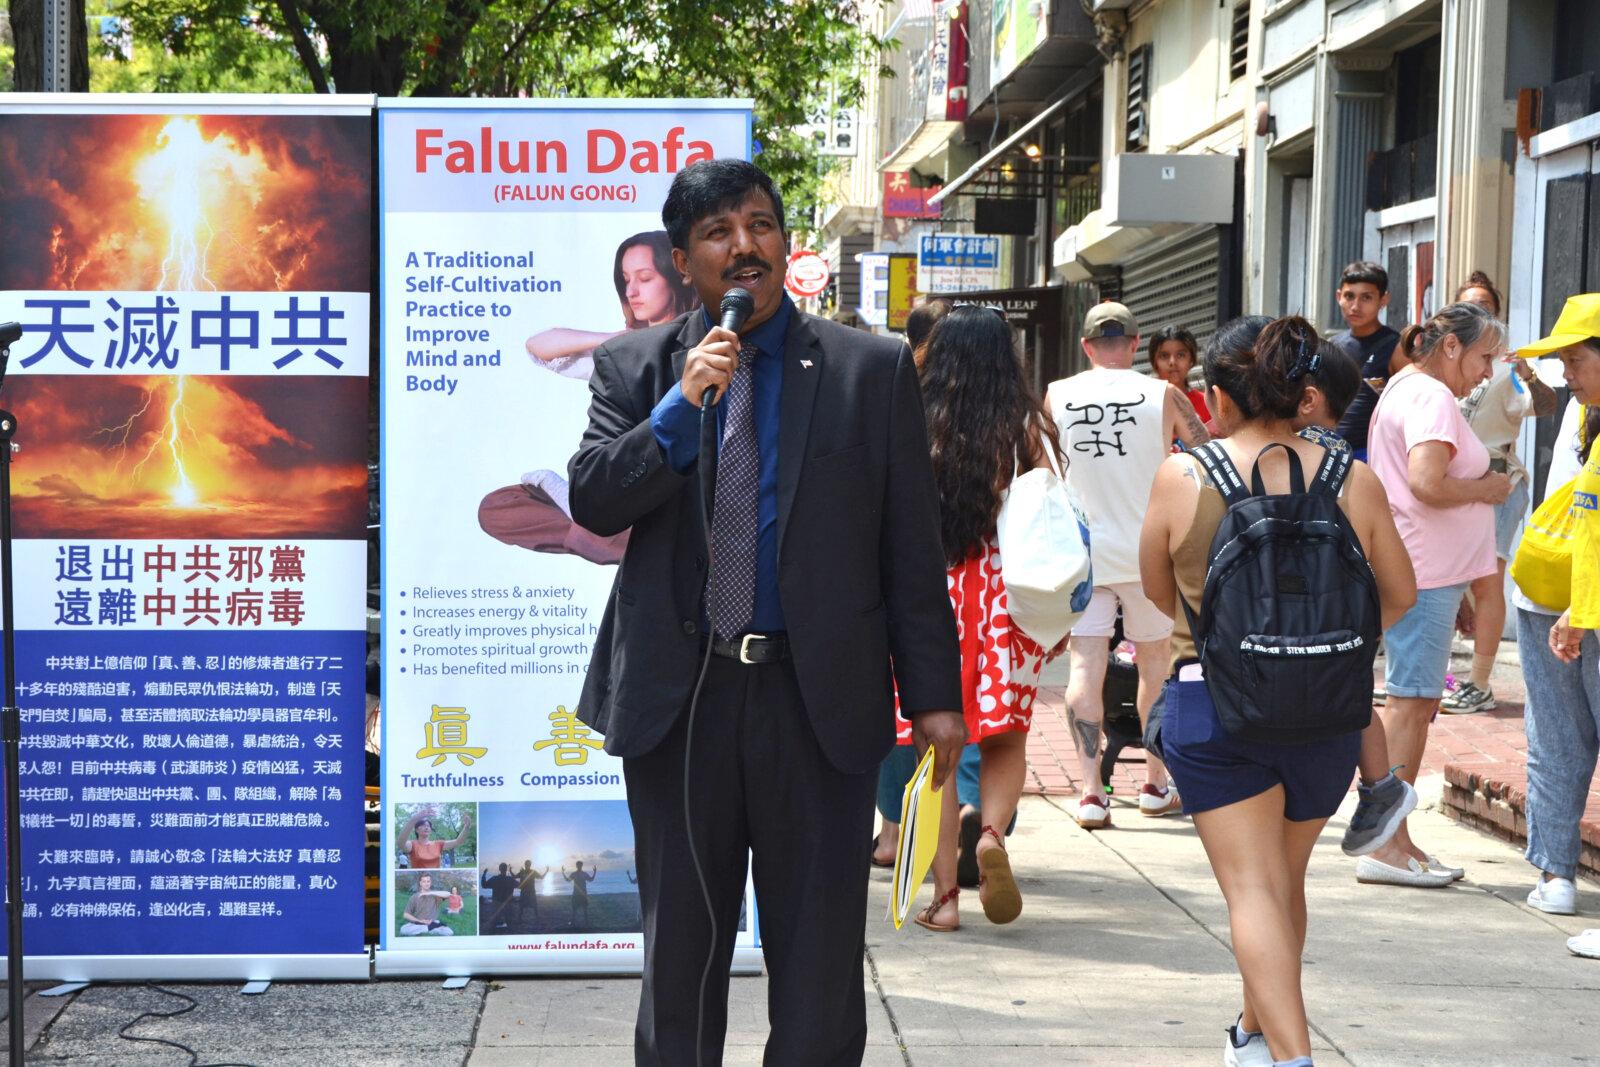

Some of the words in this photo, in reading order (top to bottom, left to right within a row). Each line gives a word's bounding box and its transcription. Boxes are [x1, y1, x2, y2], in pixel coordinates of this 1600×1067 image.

[415, 127, 568, 174] Falun
[586, 126, 715, 174] Dafa
[494, 184, 568, 202] (FALUN
[570, 184, 637, 202] GONG)
[405, 252, 420, 268] A
[423, 251, 534, 269] Traditional
[405, 275, 562, 293] Self-Cultivation
[405, 301, 486, 317] Practice
[491, 303, 512, 317] to
[1007, 300, 1038, 310] LEAF
[19, 295, 348, 371] 天滅中共
[405, 326, 490, 346] Improve
[405, 350, 458, 367] Mind
[463, 350, 501, 367] and
[405, 374, 458, 395] Body
[55, 544, 306, 584] 退出中共邪黨
[412, 586, 467, 599] Relieves
[471, 588, 509, 599] stress
[512, 586, 522, 598] &
[525, 586, 575, 601] anxiety
[54, 587, 306, 626] 遠離中共病毒
[412, 605, 475, 618] Increases
[478, 607, 525, 620] energy
[529, 605, 539, 617] &
[542, 604, 588, 619] vitality
[412, 624, 461, 640] Greatly
[465, 624, 528, 639] improves
[531, 623, 585, 639] physical
[589, 623, 599, 635] h
[412, 643, 478, 656] Promotes
[481, 642, 535, 658] spiritual
[539, 641, 588, 657] growth
[412, 663, 438, 675] Has
[441, 662, 507, 675] benefited
[510, 661, 563, 674] millions
[567, 661, 580, 674] in
[533, 704, 605, 767] 善
[401, 773, 505, 788] Truthfulness
[520, 771, 620, 789] Compassion
[21, 874, 338, 892] 」，九字真言裡面，蘊涵著宇宙純正的能量，真心
[508, 940, 635, 949] www.falundafa.org
